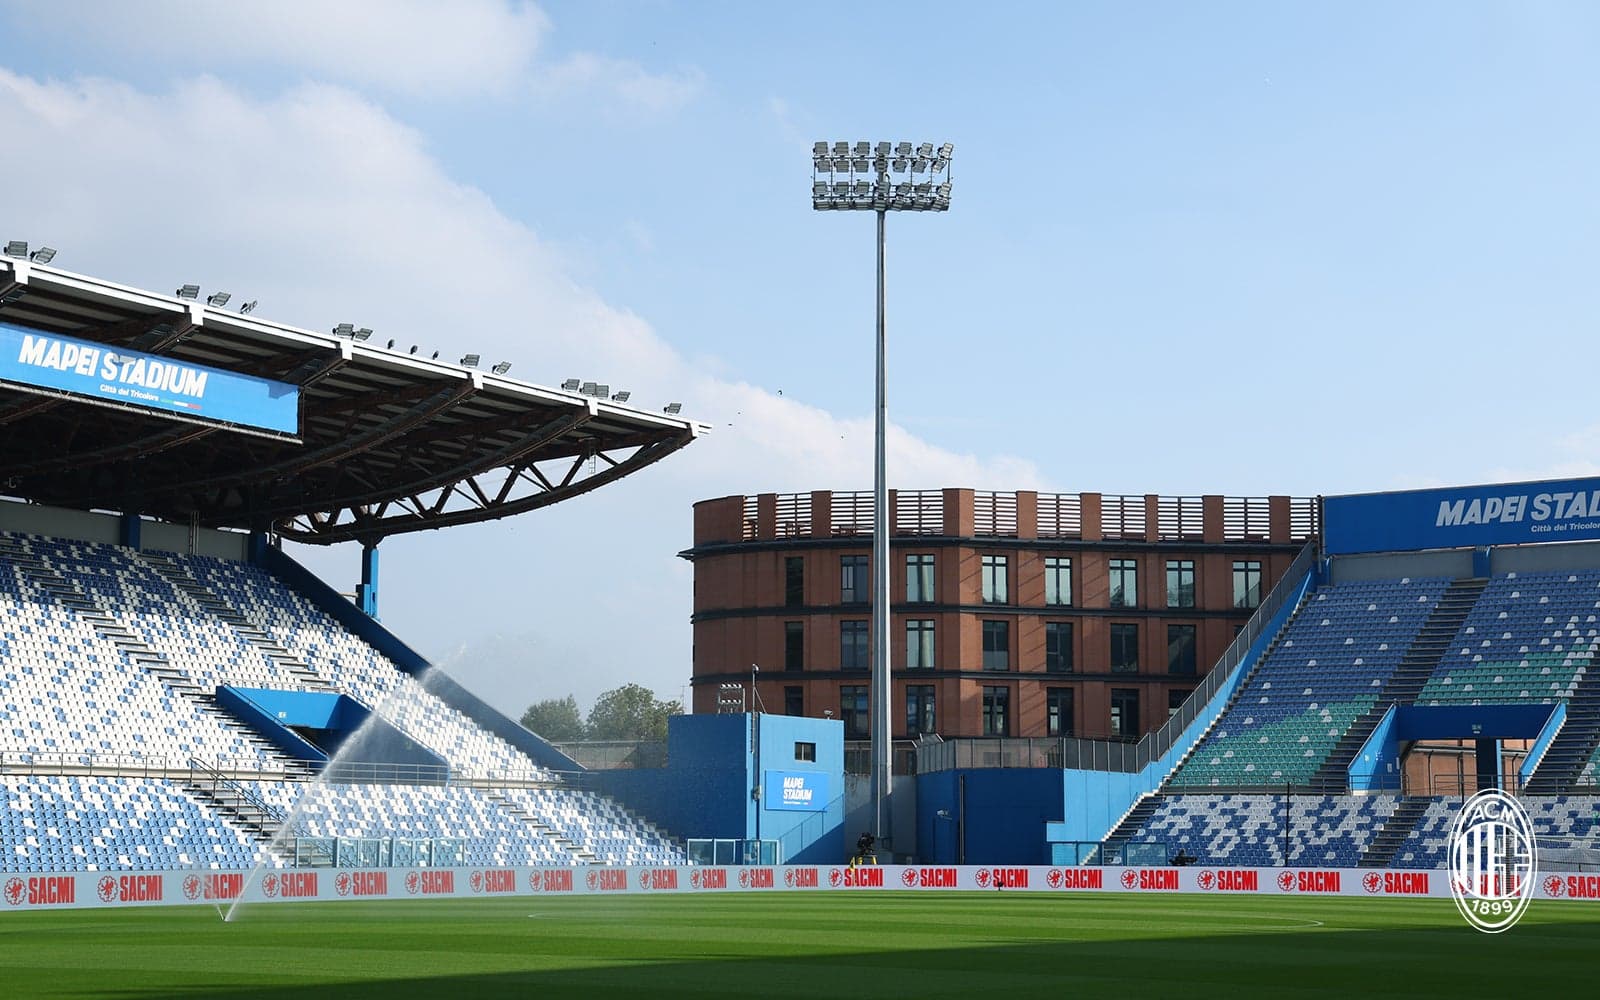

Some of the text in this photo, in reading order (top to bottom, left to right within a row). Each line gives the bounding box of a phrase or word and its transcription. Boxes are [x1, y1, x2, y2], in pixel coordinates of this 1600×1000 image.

[18, 335, 208, 399] MAPEI STADIUM
[1436, 495, 1528, 527] MAPEI
[1531, 523, 1552, 533] Città
[1553, 523, 1568, 532] del
[783, 776, 805, 789] MAPEI
[783, 788, 813, 801] STADIUM
[120, 875, 163, 901] SACMI
[204, 873, 244, 899] SACMI
[281, 872, 318, 897] SACMI
[352, 871, 388, 896] SACMI
[422, 870, 454, 895] SACMI
[485, 869, 515, 893] SACMI
[544, 869, 573, 892] SACMI
[601, 869, 627, 889] SACMI
[652, 869, 678, 889] SACMI
[701, 867, 727, 889] SACMI
[750, 868, 775, 888] SACMI
[795, 868, 819, 888] SACMI
[844, 868, 884, 887] SACMI
[920, 868, 957, 887] SACMI
[992, 868, 1029, 888] SACMI
[1065, 868, 1103, 889] SACMI
[1140, 869, 1179, 890] SACMI
[1217, 869, 1258, 891] SACMI
[1297, 870, 1340, 892] SACMI
[1384, 871, 1429, 894] SACMI
[1567, 875, 1600, 898] SAC
[29, 876, 75, 903] SACMI
